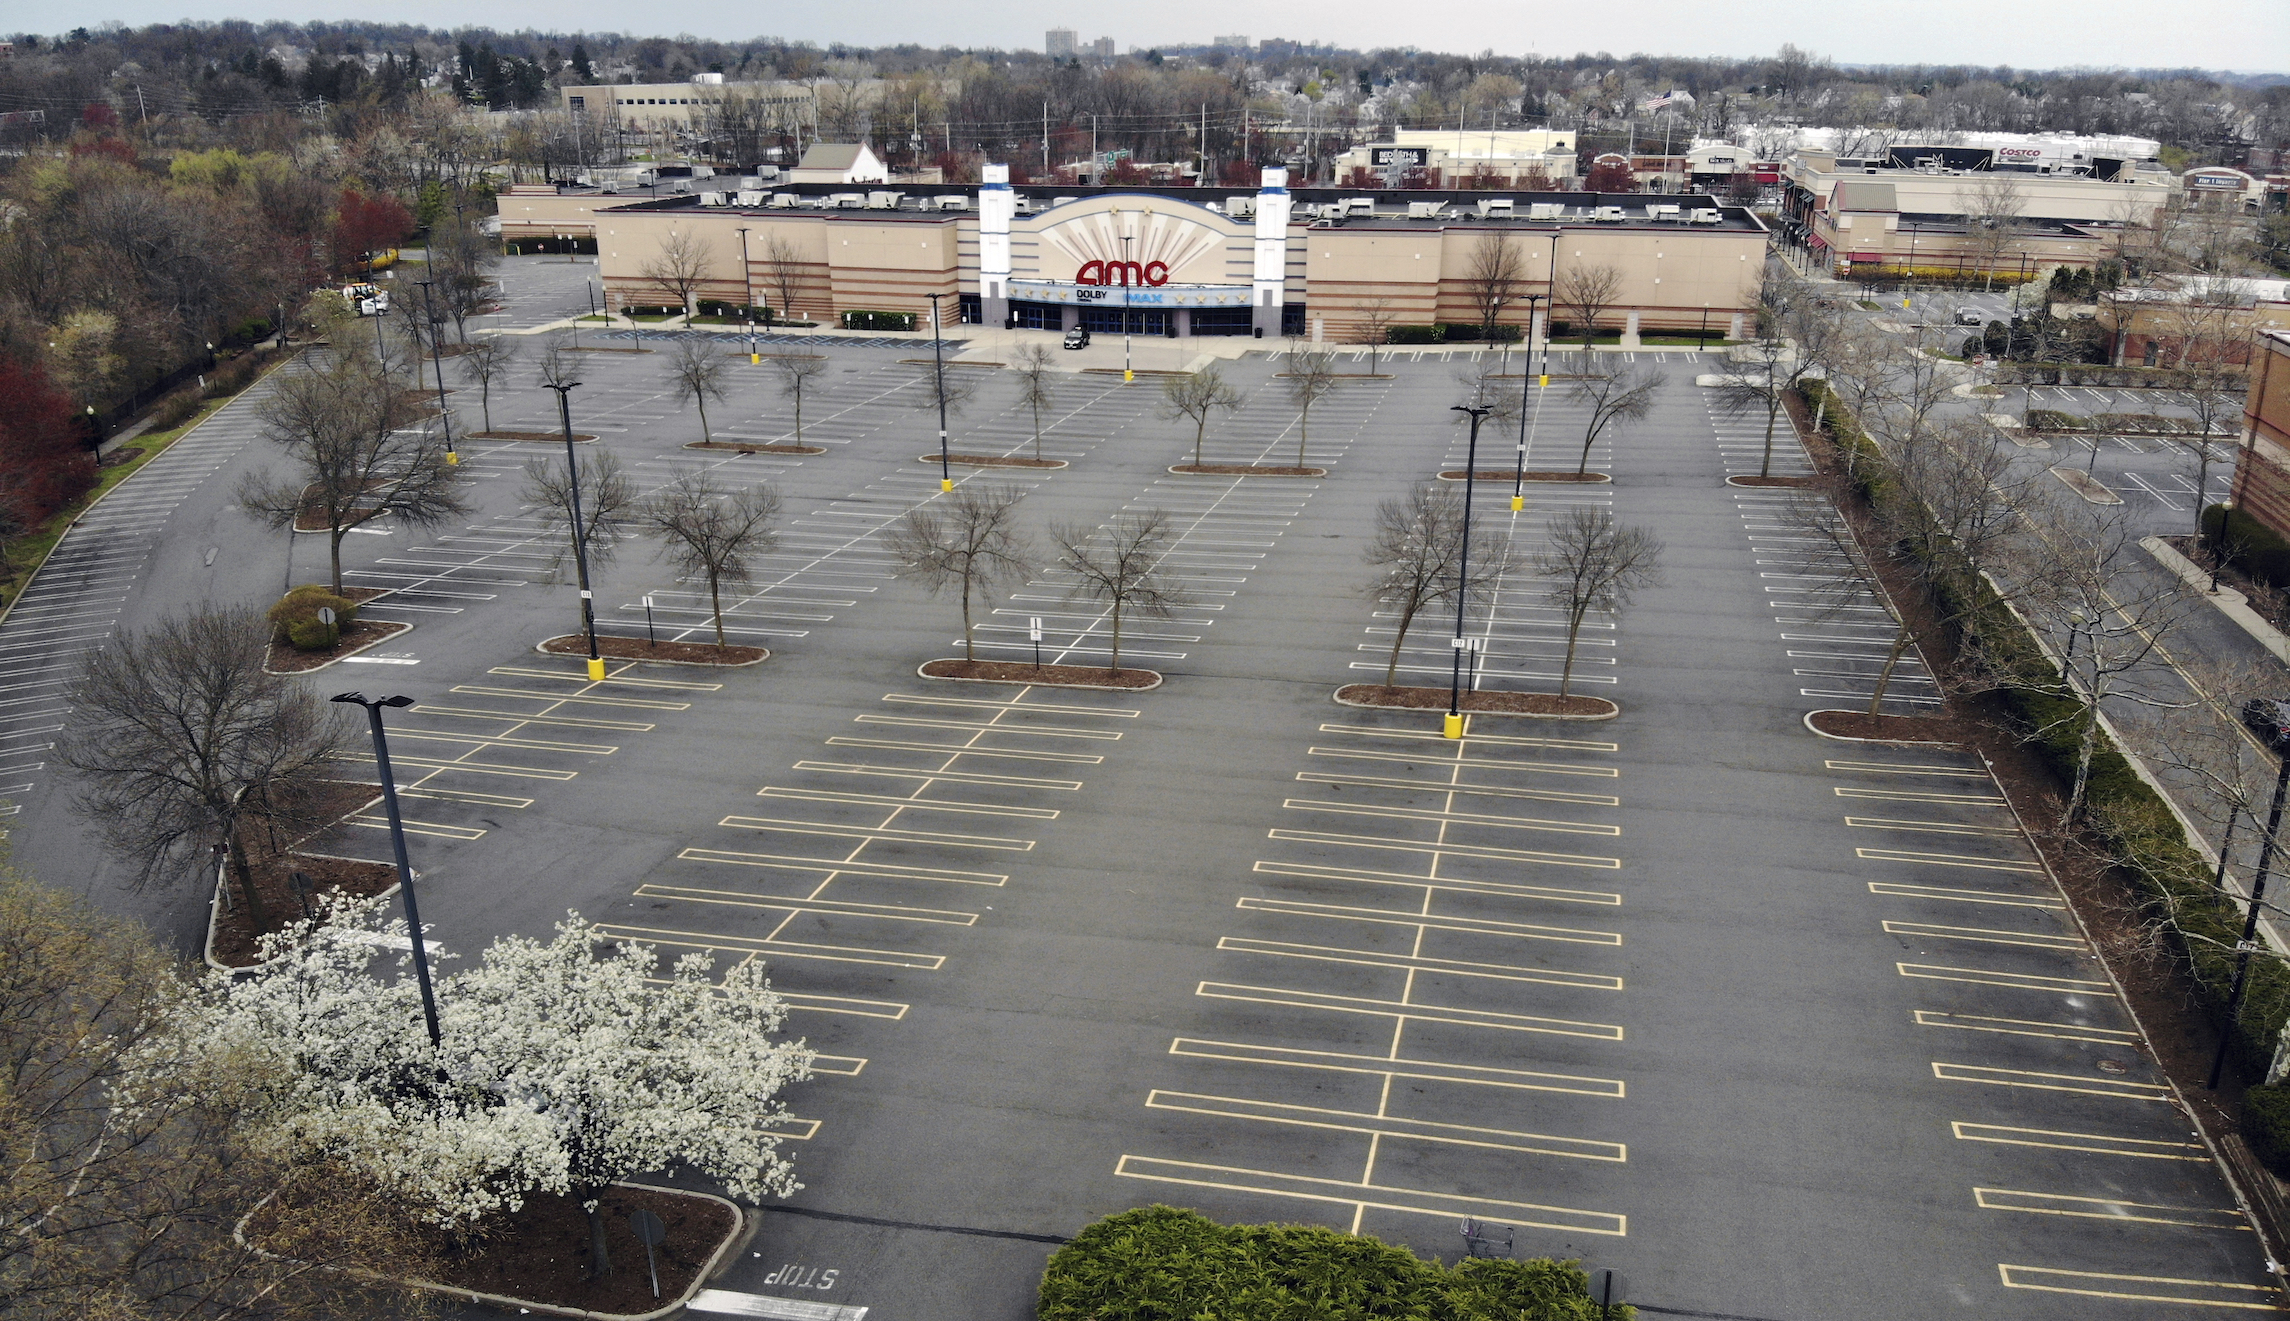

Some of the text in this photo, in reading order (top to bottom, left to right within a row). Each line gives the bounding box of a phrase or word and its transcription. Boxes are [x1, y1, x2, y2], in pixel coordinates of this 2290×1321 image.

[2000, 147, 2041, 157] COSTCO
[1076, 289, 1107, 299] DOLBY
[1123, 293, 1163, 303] IMAX
[763, 1264, 840, 1290] STOP
